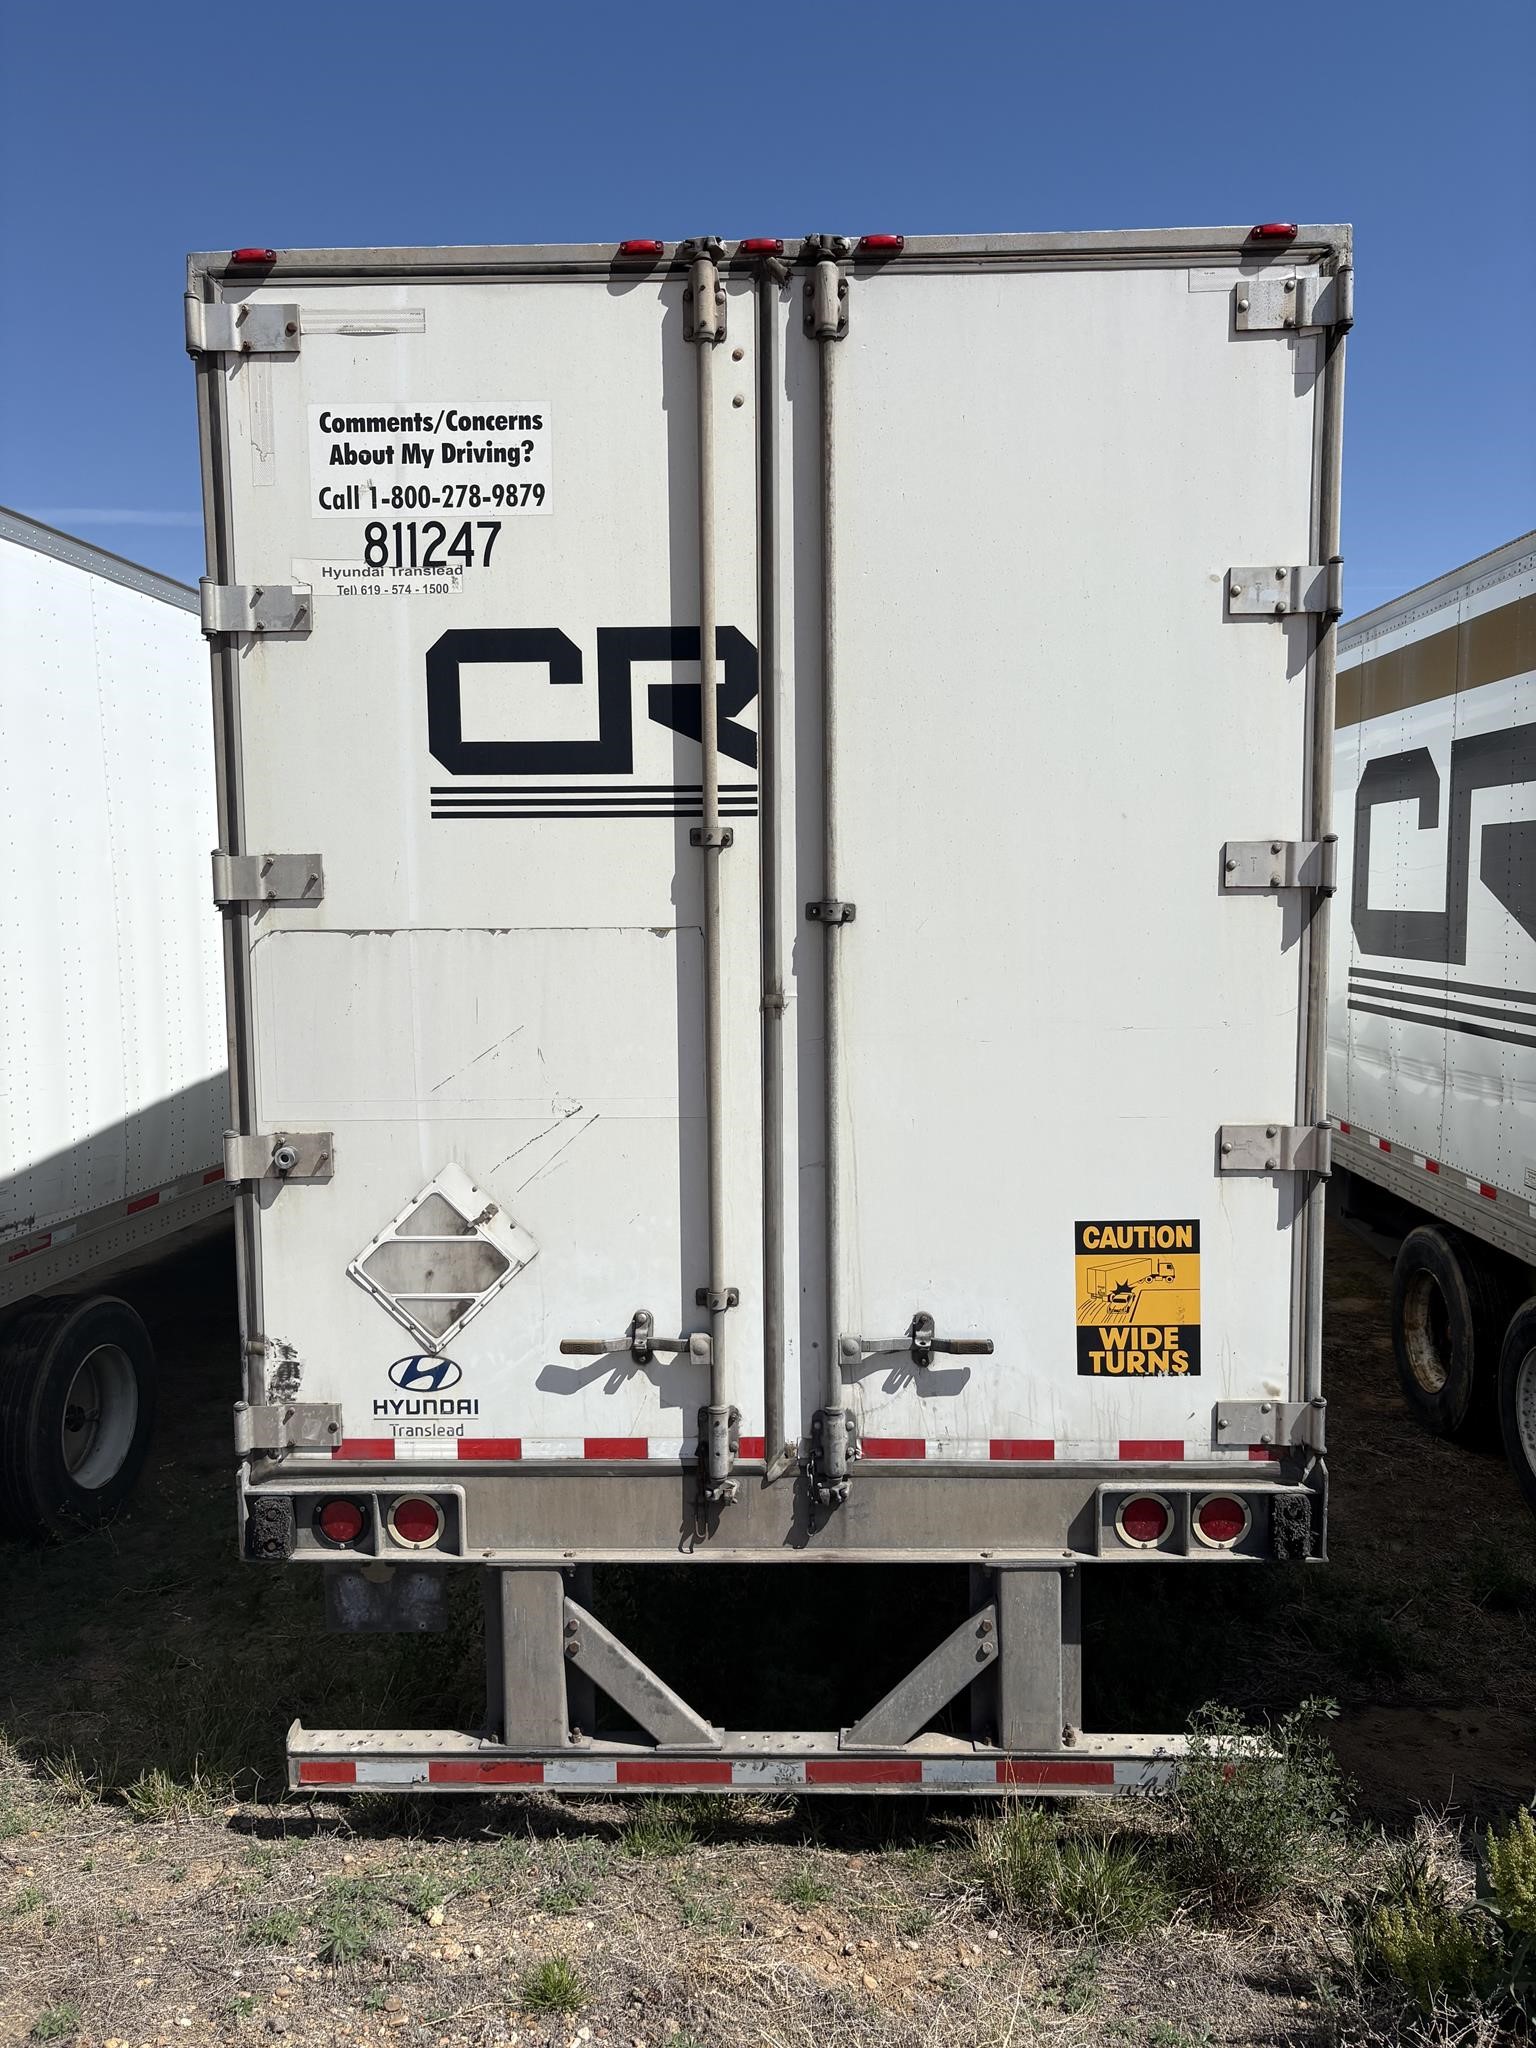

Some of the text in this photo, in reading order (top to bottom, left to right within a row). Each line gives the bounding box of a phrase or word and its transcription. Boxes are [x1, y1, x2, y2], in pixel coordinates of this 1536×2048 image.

[319, 410, 543, 434] Comments/Concerns
[329, 440, 535, 469] About My Driving?
[318, 483, 546, 510] Call 1-800-278-9879
[364, 521, 502, 568] 811247
[322, 565, 463, 580] Hyundai Translead
[360, 585, 381, 595] 619
[391, 584, 411, 594] 574
[423, 583, 449, 594] 1500
[1082, 1225, 1193, 1249] CAUTION
[1099, 1327, 1179, 1350] WIDE
[1088, 1350, 1189, 1374] TURNS
[373, 1400, 479, 1415] HYUNDAI
[389, 1424, 464, 1437] Translead
